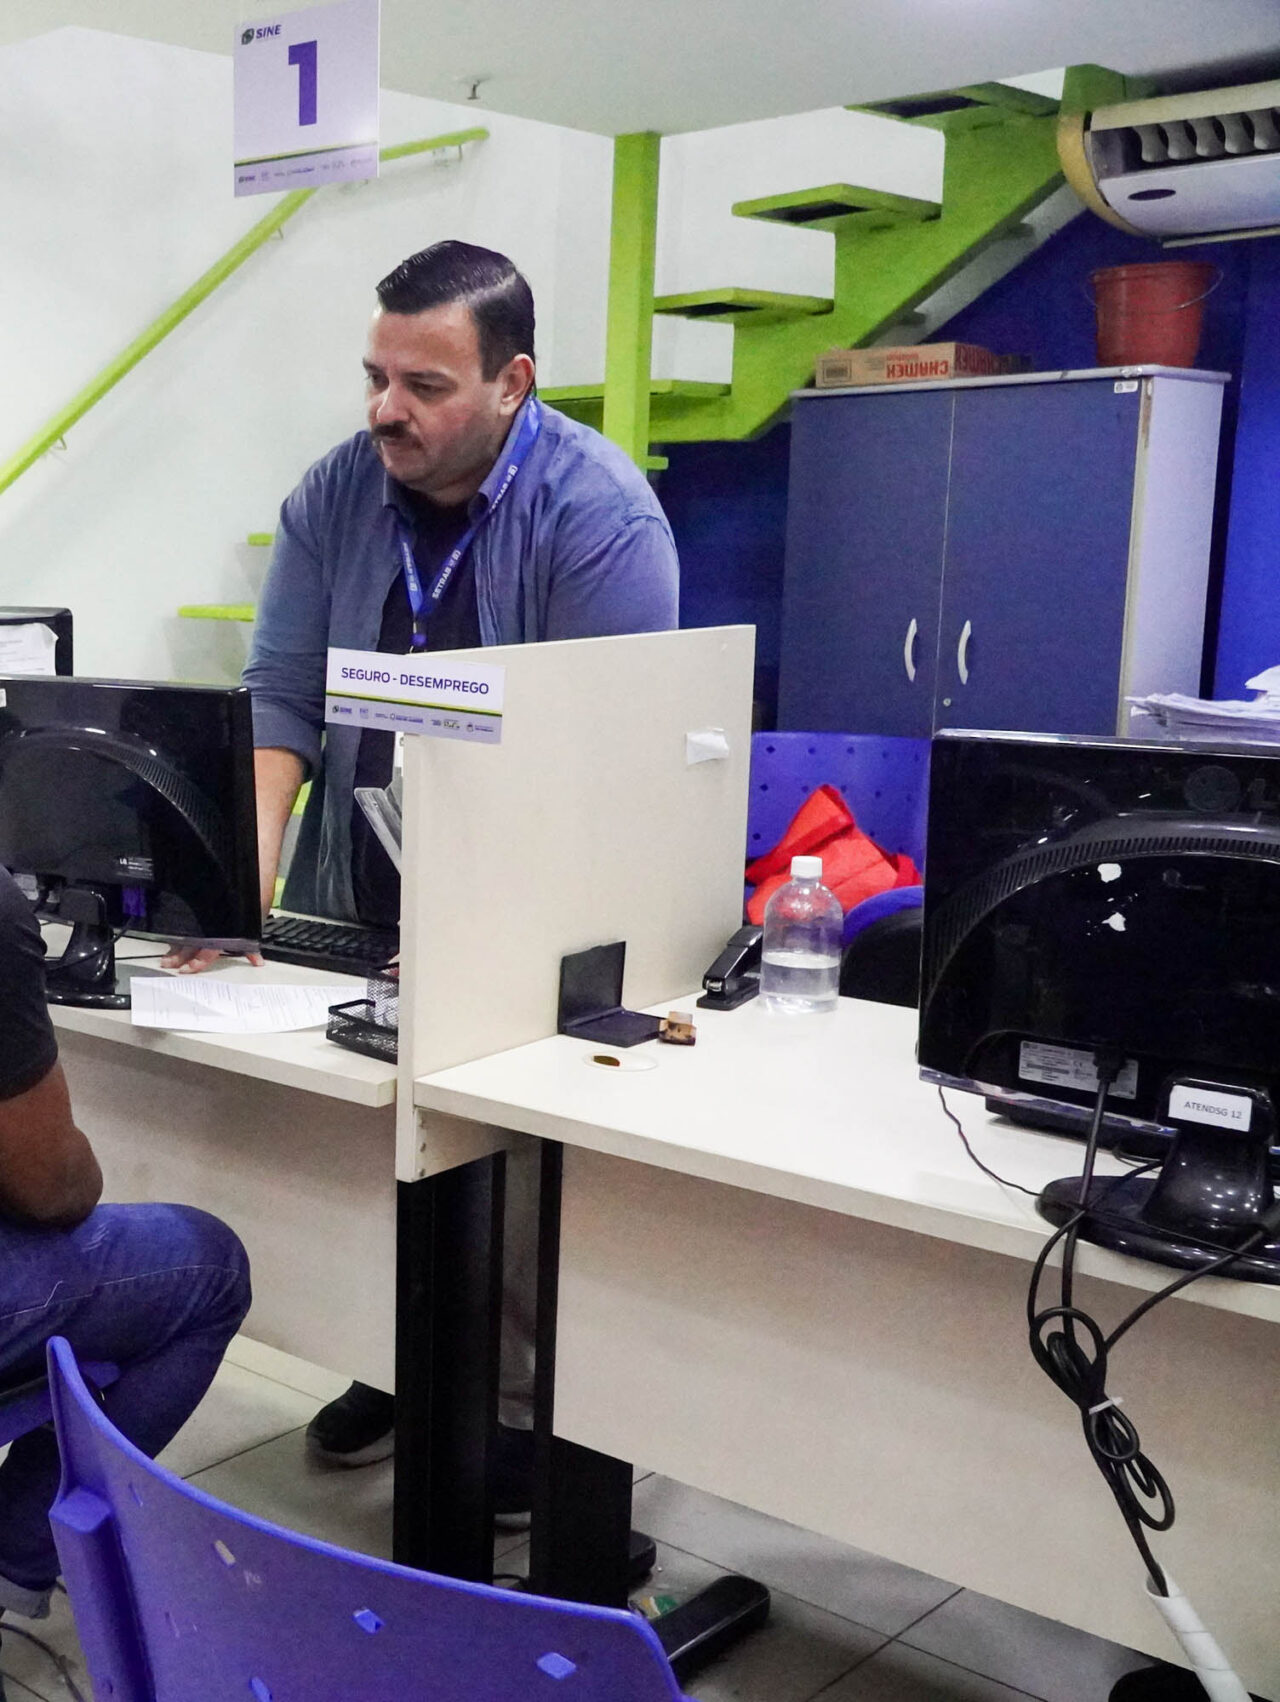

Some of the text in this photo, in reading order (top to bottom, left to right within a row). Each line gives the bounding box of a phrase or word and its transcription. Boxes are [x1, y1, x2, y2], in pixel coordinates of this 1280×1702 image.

[256, 24, 282, 39] SINE
[288, 40, 317, 126] 1
[341, 667, 391, 684] SEGURO
[400, 673, 489, 695] DESEMPREGO
[1183, 1100, 1242, 1119] ATENDSG 12
